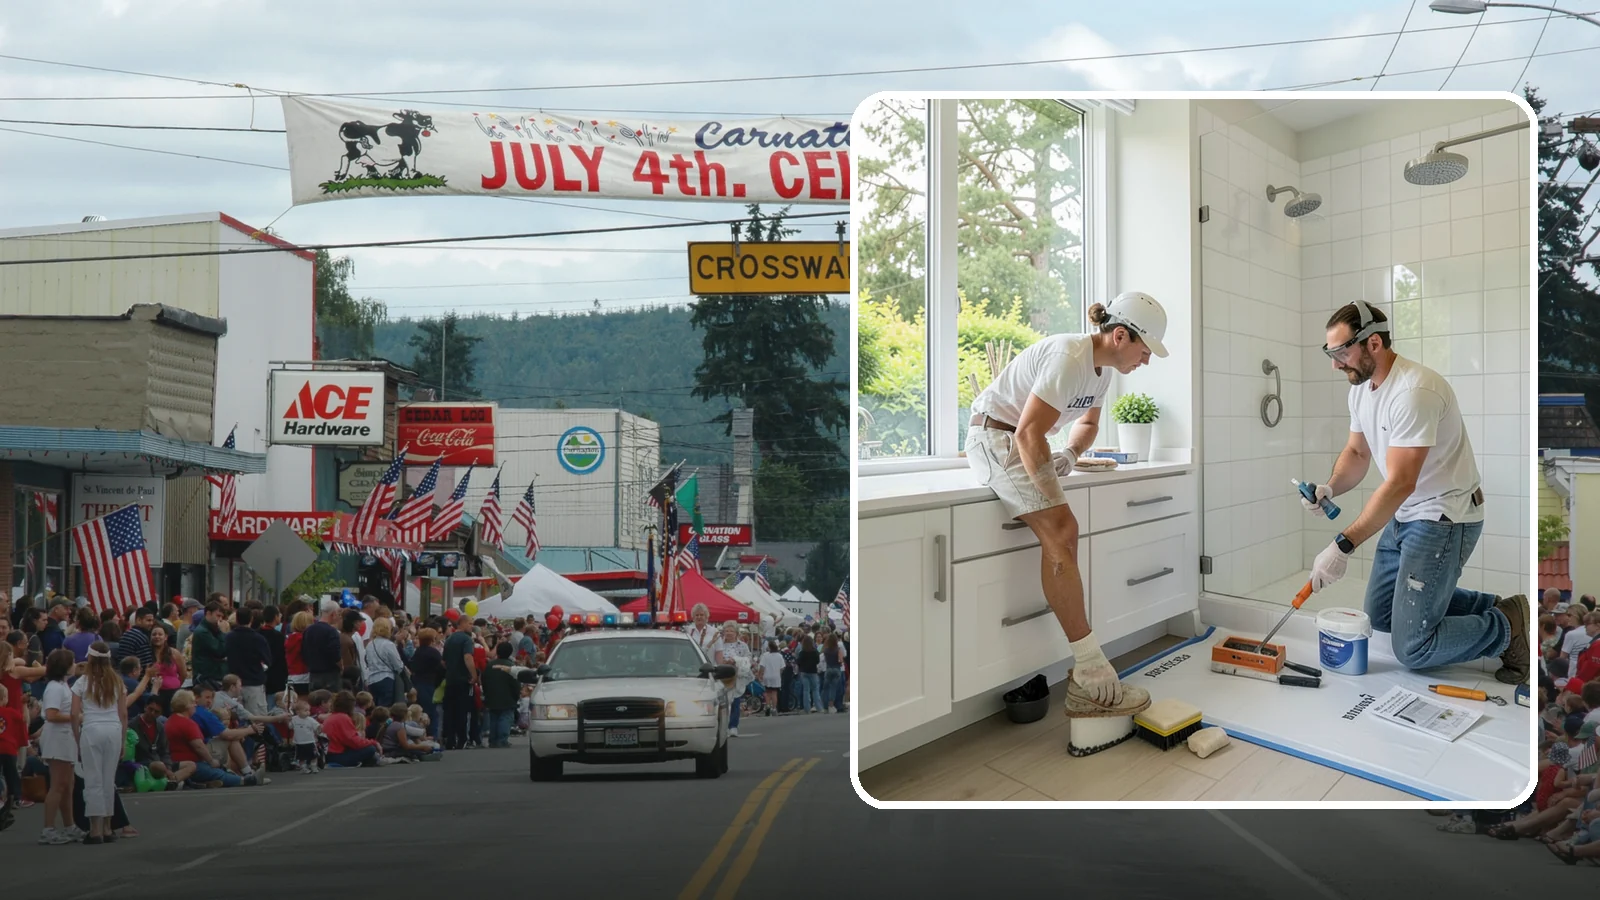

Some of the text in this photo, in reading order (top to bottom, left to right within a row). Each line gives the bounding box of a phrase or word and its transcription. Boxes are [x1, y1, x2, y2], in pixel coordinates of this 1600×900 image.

[695, 121, 850, 150] Carnat
[481, 141, 605, 193] JULY
[632, 150, 746, 198] 4th.
[697, 254, 850, 280] CROSSWA
[283, 380, 373, 420] ACE
[405, 408, 452, 421] CEDAR
[283, 421, 371, 437] Hardware
[354, 467, 386, 481] Simpl
[95, 485, 124, 494] Vincent
[126, 485, 136, 494] de
[137, 486, 155, 495] Paul
[81, 503, 154, 522] THT
[212, 516, 331, 536] HARDARE
[688, 526, 741, 535] CRNATION
[699, 535, 730, 543] GLASS
